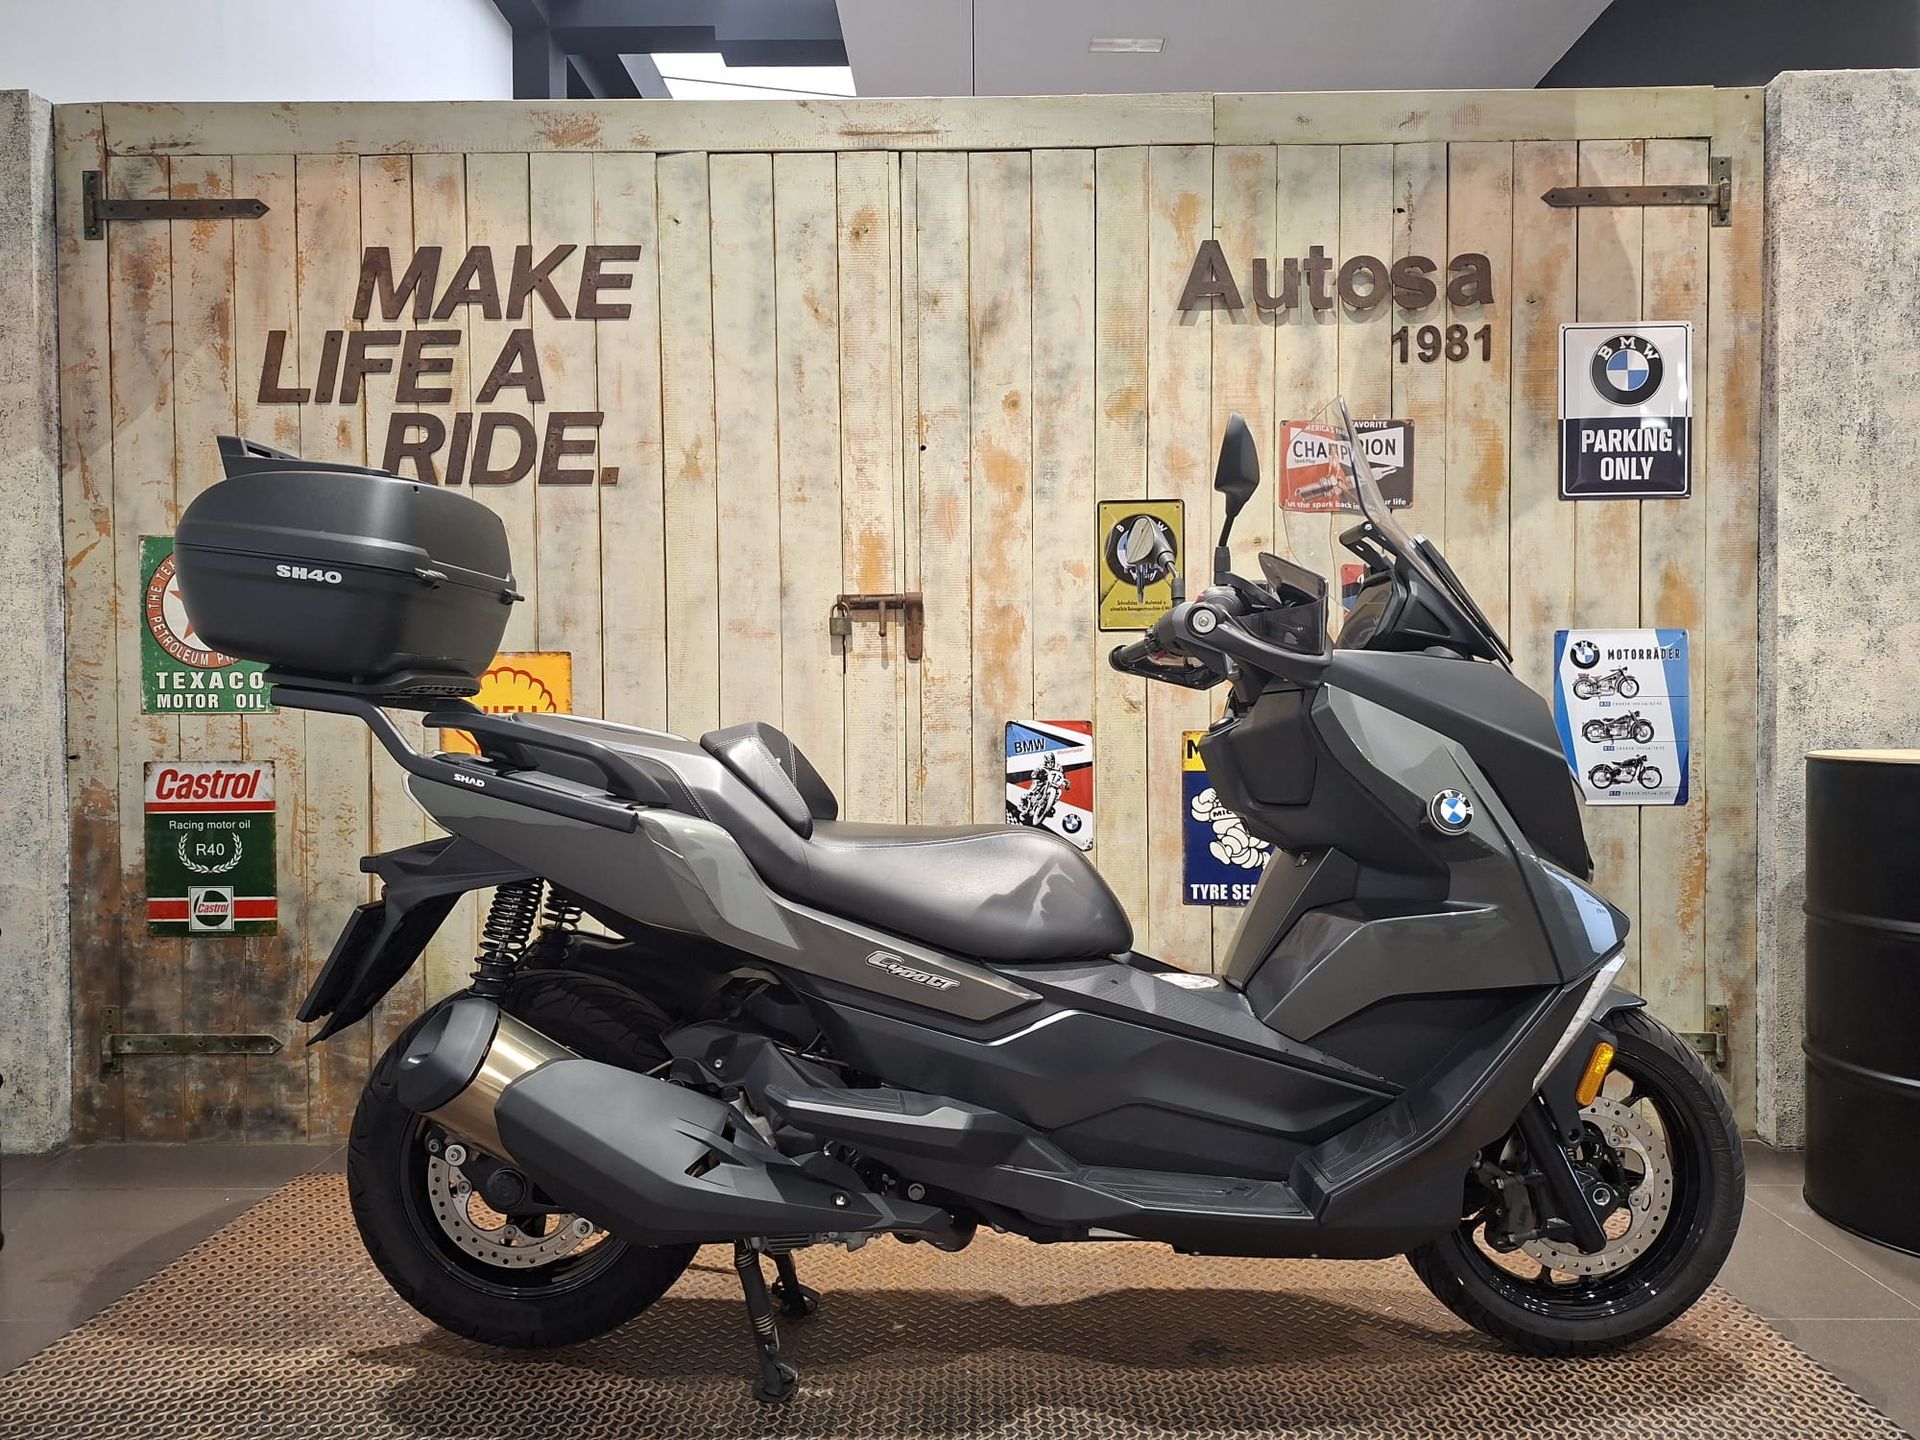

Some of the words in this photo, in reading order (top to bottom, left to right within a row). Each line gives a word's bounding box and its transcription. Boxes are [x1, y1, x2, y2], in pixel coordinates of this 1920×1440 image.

[353, 245, 642, 320] MAKE
[1177, 240, 1494, 310] Autosa
[1392, 324, 1491, 363] 1981
[1598, 336, 1659, 361] BMW
[257, 330, 462, 404] LIFE
[475, 329, 546, 403] A
[382, 411, 620, 486] RIDE.
[1581, 428, 1673, 453] PARKING
[1600, 456, 1653, 481] ONLY
[1312, 501, 1334, 510] spark
[276, 564, 342, 584] SH40
[150, 616, 209, 666] PETROLEUM
[156, 671, 265, 690] TEXACO
[156, 693, 219, 709] MOTOR
[236, 693, 265, 709] OIL
[1014, 738, 1045, 754] BMW
[155, 769, 261, 800] Castrol
[453, 773, 485, 788] SHAD
[1445, 790, 1473, 815] BMW
[169, 820, 204, 831] Racing
[207, 820, 235, 830] motor
[238, 819, 251, 829] oil
[196, 843, 225, 856] R40
[1190, 884, 1228, 900] TYRE
[197, 901, 229, 913] Castrol
